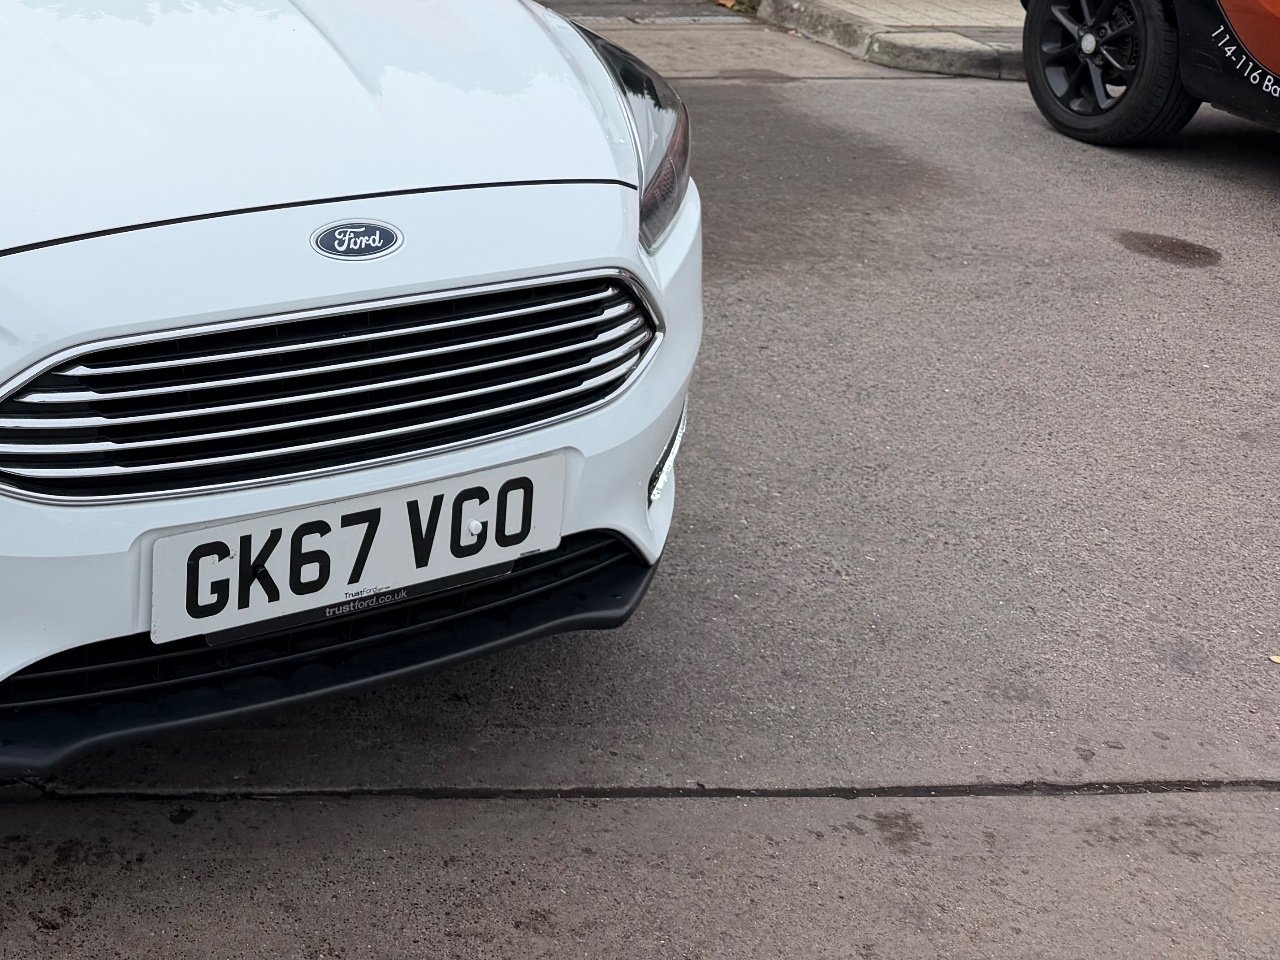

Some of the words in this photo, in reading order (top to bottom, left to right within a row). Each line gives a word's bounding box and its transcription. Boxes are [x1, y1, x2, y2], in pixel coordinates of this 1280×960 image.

[1211, 25, 1262, 85] 114-116
[334, 227, 384, 252] Ford
[185, 507, 381, 619] GK67
[406, 476, 534, 570] VGO
[324, 589, 408, 617] trustford.co.uk
